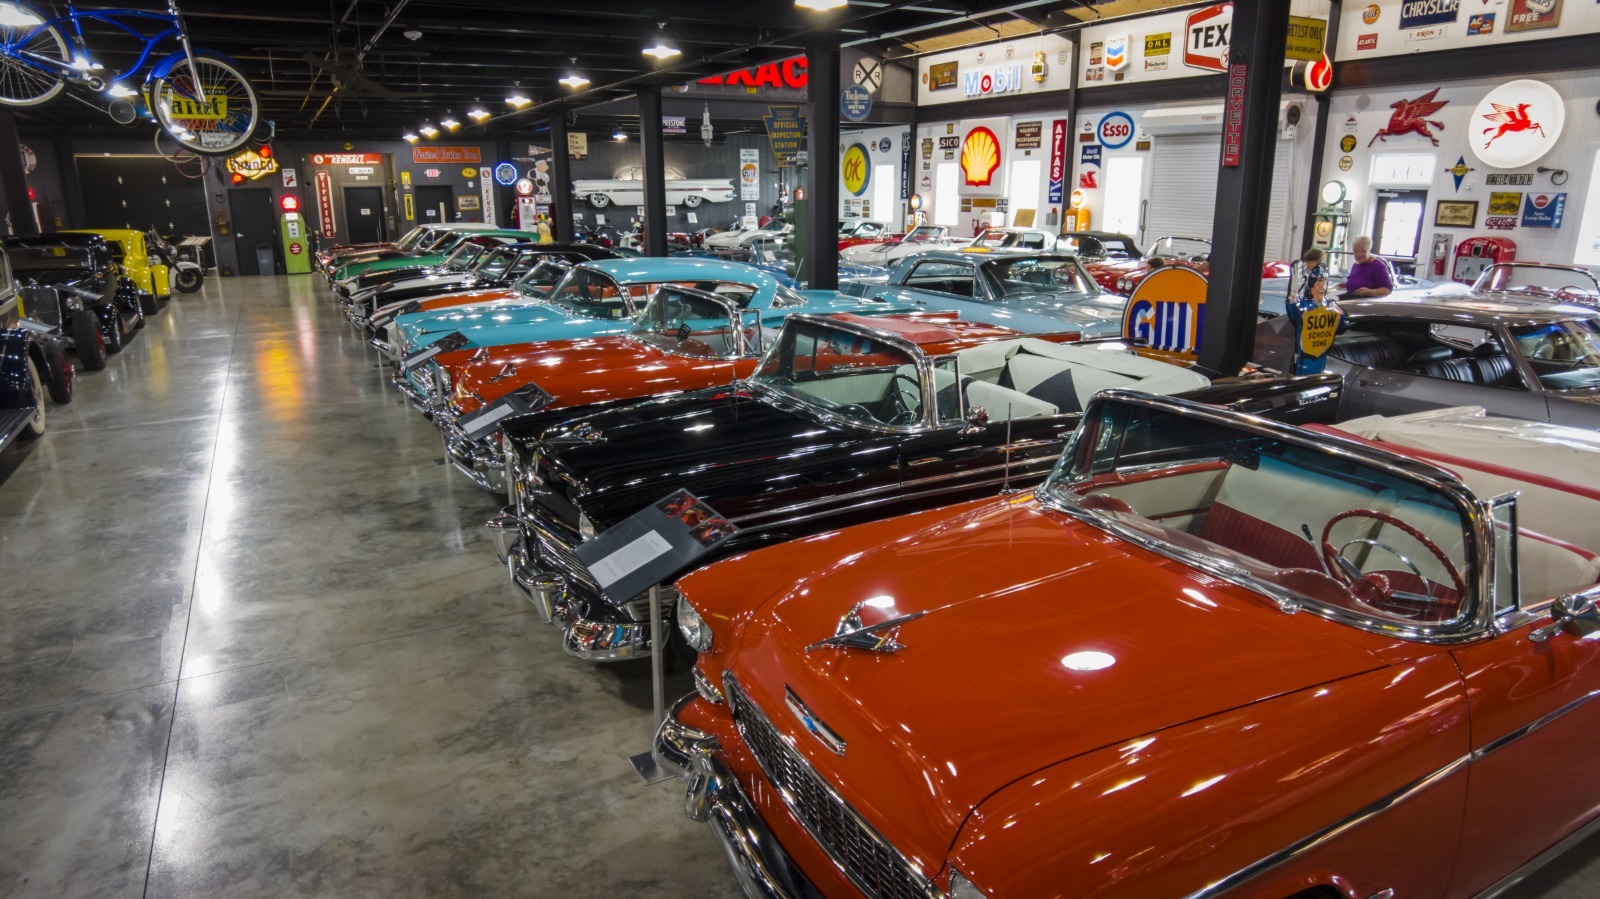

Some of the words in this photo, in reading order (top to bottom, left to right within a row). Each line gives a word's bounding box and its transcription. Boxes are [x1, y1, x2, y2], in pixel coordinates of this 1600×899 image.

[1363, 9, 1379, 18] GULF
[1402, 0, 1458, 18] CHRYSLER
[1471, 17, 1482, 26] AC
[1512, 12, 1539, 24] FREE
[1192, 23, 1231, 49] TEX
[1358, 38, 1377, 46] ATLANTIC
[696, 56, 808, 89] XAC
[855, 70, 862, 79] R
[874, 71, 881, 80] R
[964, 64, 1021, 96] Mobil
[1227, 65, 1246, 155] CORVETTE
[662, 119, 685, 127] PRESTONE
[774, 141, 797, 149] STATION
[940, 138, 959, 147] SICO
[415, 148, 439, 159] United
[440, 149, 463, 159] States
[462, 148, 479, 159] Tires
[1053, 123, 1063, 178] ATLAS
[231, 158, 274, 171] SUNOCO
[844, 155, 862, 183] OK
[743, 168, 758, 178] GULF
[318, 172, 331, 237] Firestone
[1306, 313, 1337, 330] SLOW
[1308, 331, 1332, 339] SCHOOL
[1312, 340, 1328, 348] ZONE
